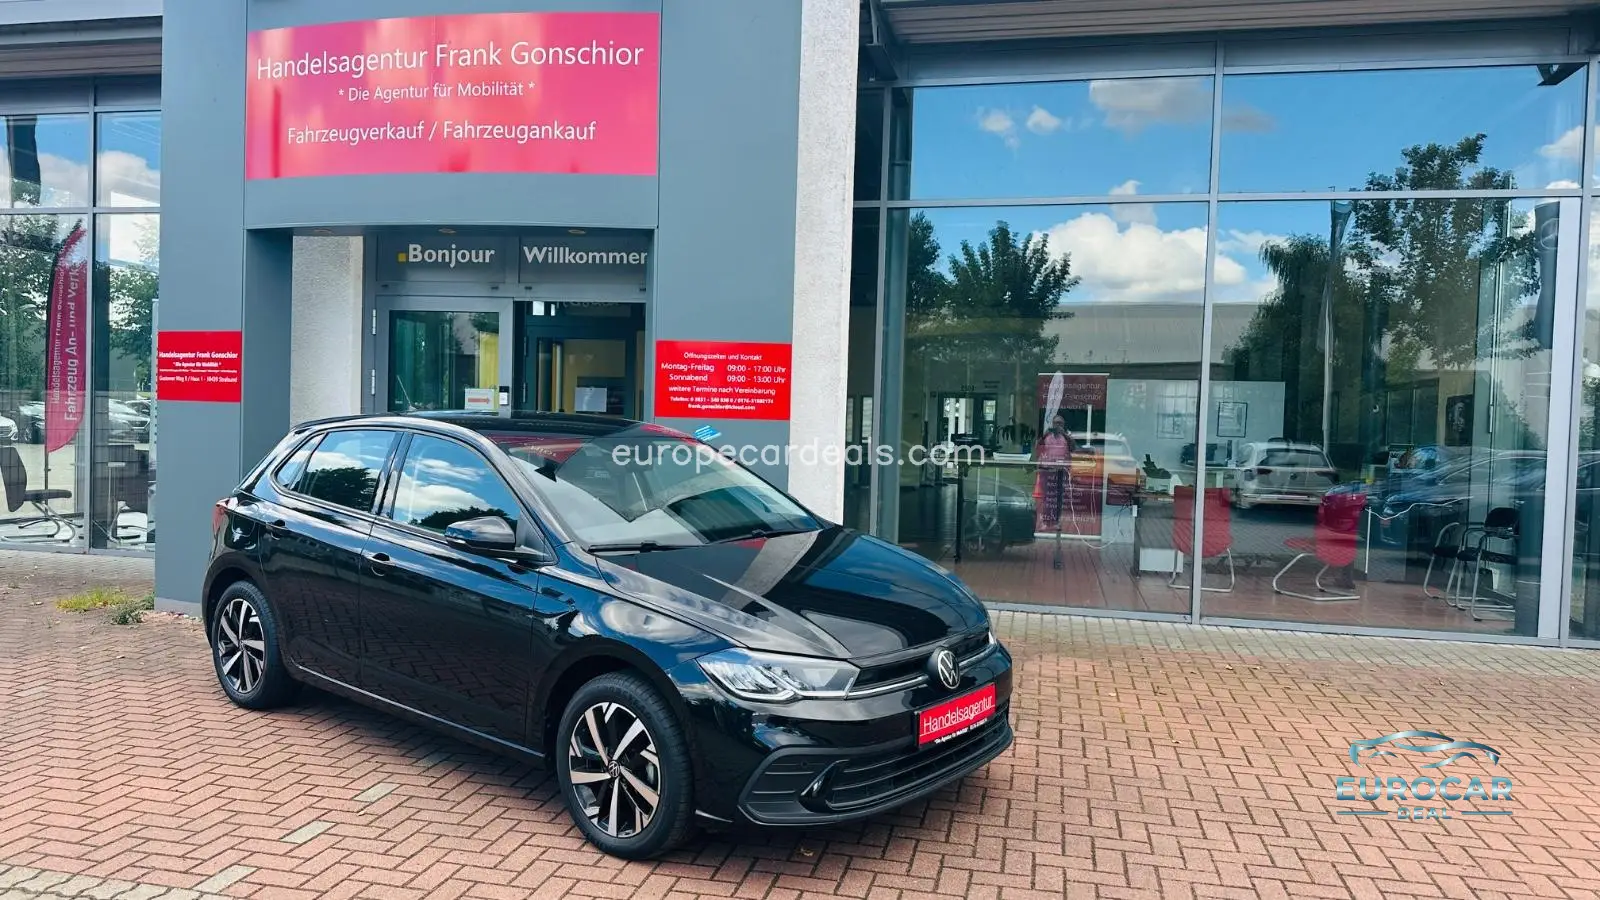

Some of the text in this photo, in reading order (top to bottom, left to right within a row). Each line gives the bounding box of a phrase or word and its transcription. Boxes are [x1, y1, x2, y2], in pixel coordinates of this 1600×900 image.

[257, 40, 644, 81] Handelsagentur Frank Gonschior
[348, 81, 524, 104] Die Agentur für Mobilität
[287, 121, 425, 145] Fahrzeugverkauf
[443, 120, 597, 145] Fahrzeugankauf
[408, 243, 495, 268] Bonjour
[661, 362, 715, 373] Montag-Freitag
[726, 364, 747, 372] 09:00
[753, 365, 772, 373] 17:00
[773, 366, 786, 374] Uhr
[669, 373, 709, 382] Sonnabend
[726, 375, 746, 383] 09:00
[753, 376, 772, 384] 13:00
[64, 358, 78, 421] Fahrzeug
[692, 386, 718, 394] Termine
[718, 386, 734, 394] nach
[734, 386, 776, 396] Vereinbarung
[923, 695, 993, 735] Handelsagentur
